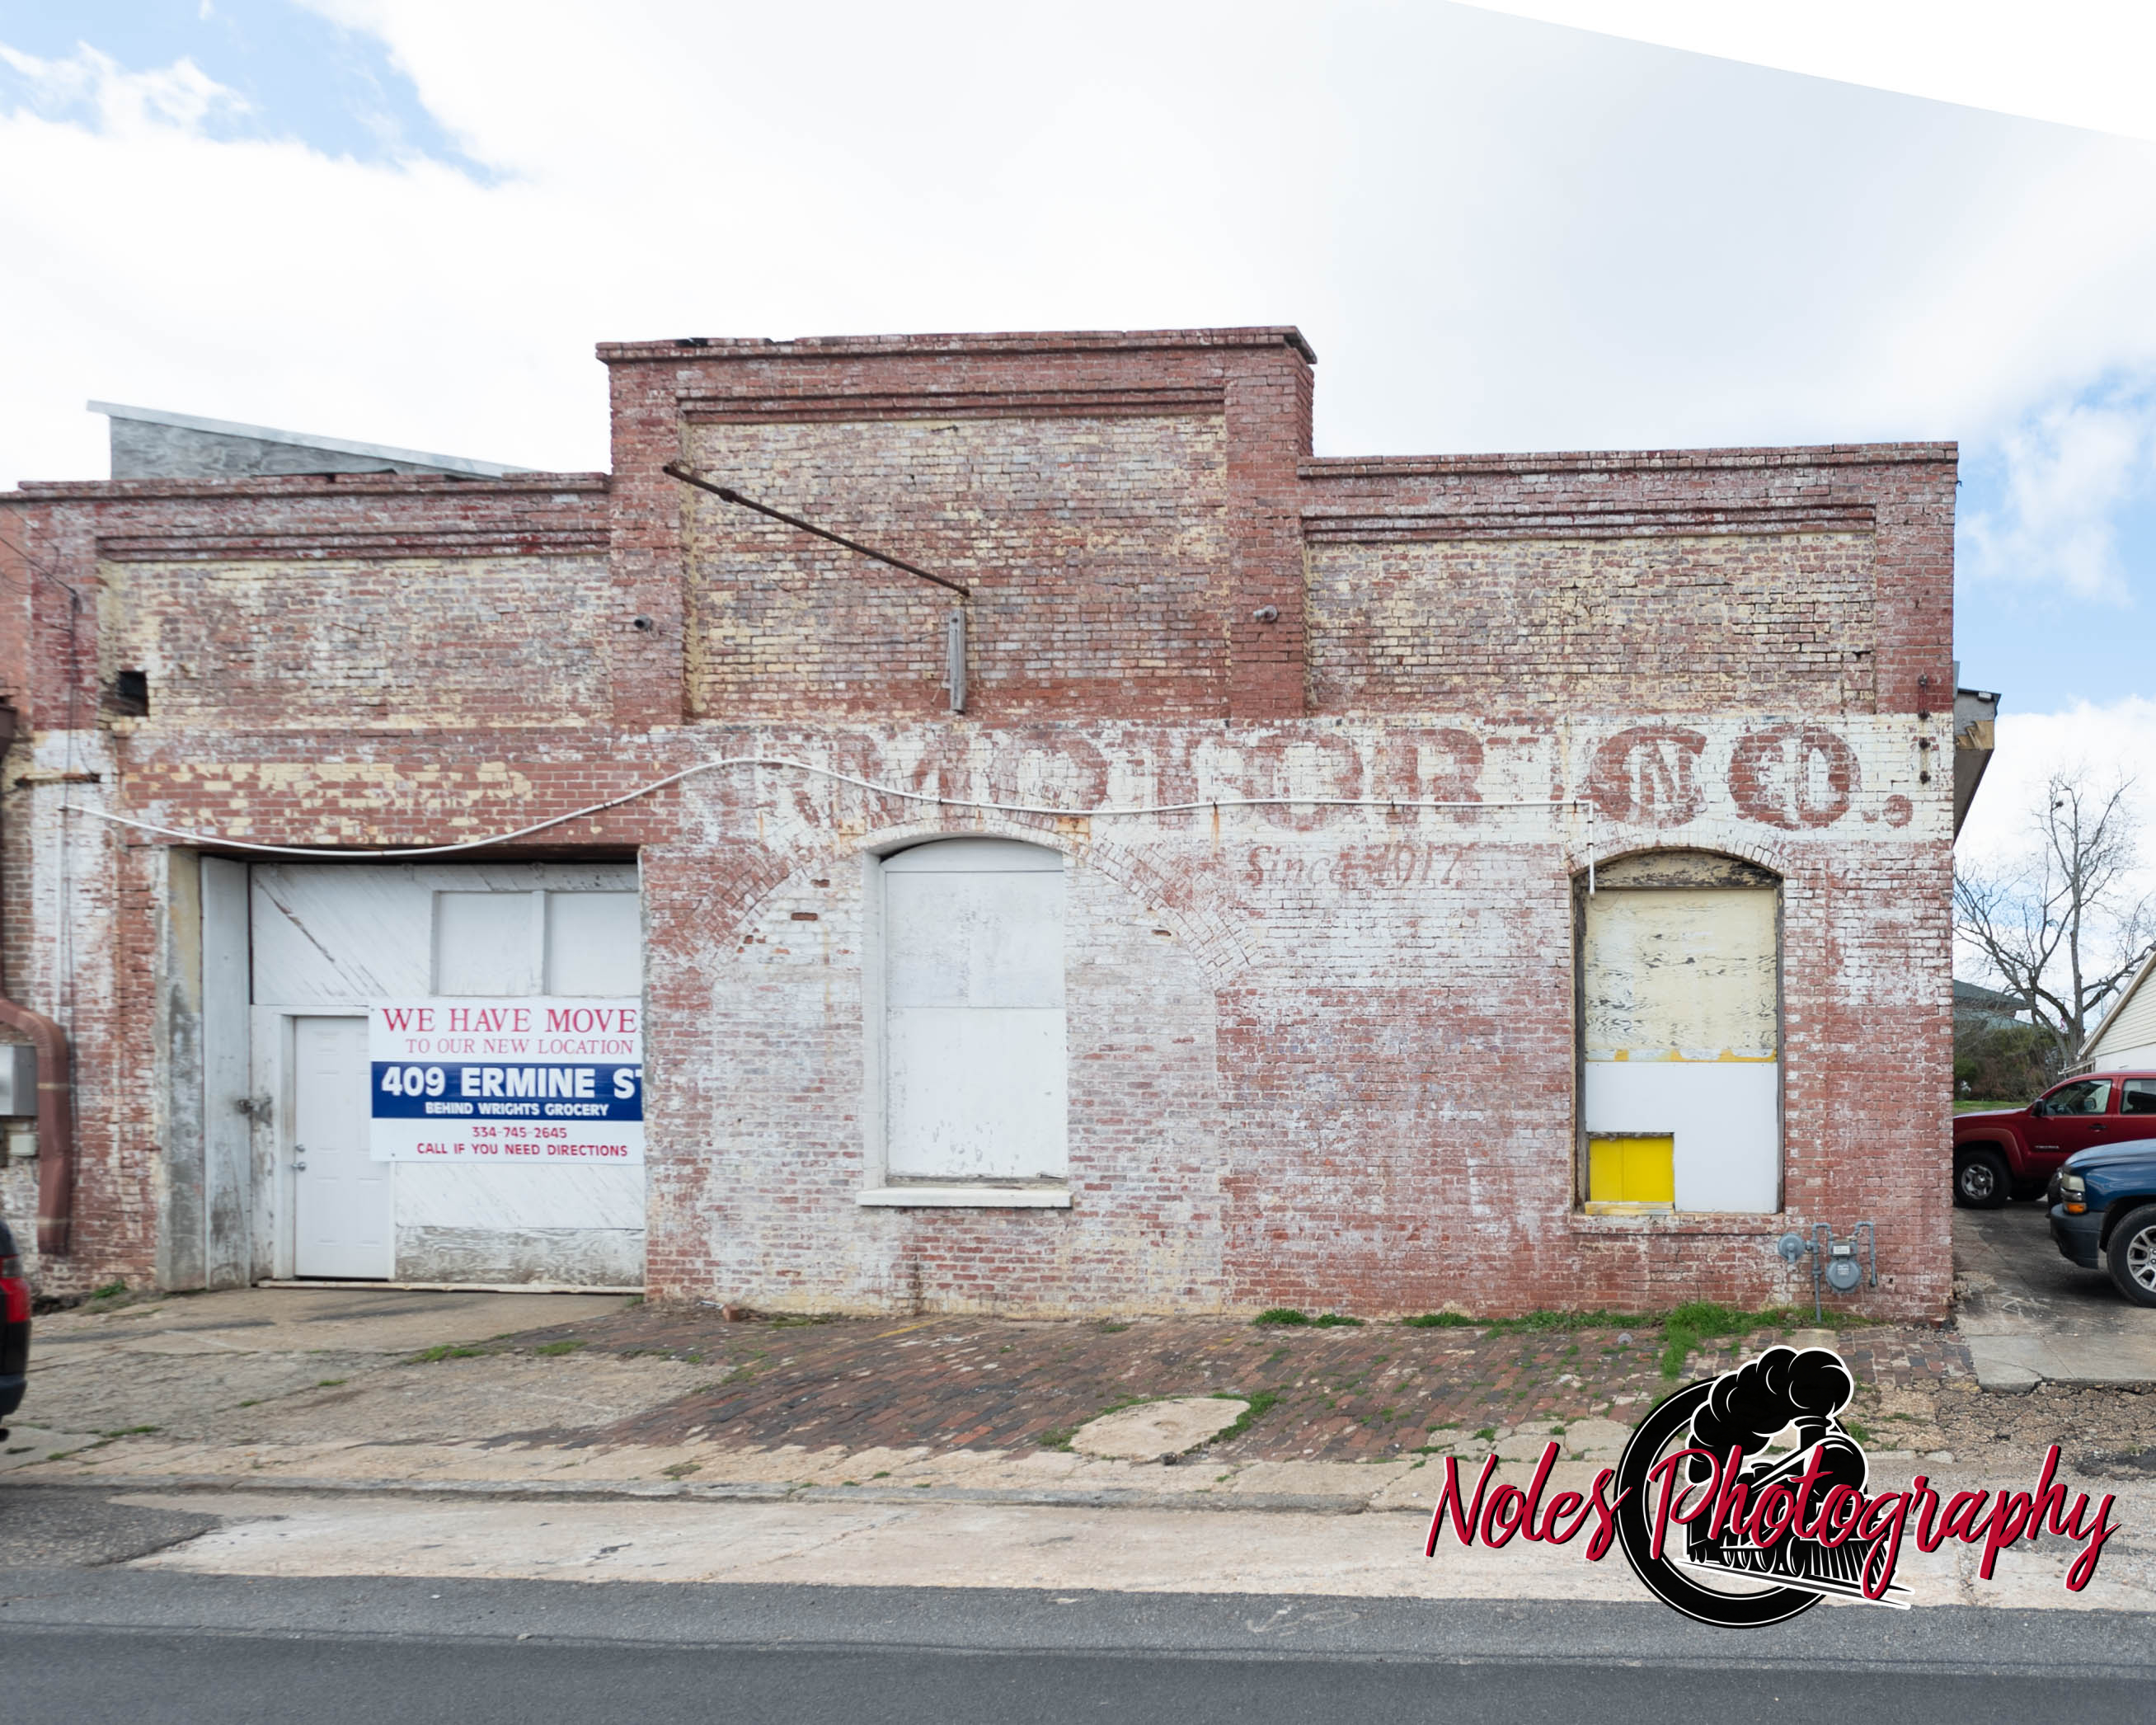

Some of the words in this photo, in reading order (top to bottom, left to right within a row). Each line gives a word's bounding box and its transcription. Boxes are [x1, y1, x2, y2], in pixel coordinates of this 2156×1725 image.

[382, 1008, 436, 1032] WE
[448, 1008, 532, 1033] HAVE
[545, 1008, 641, 1034] MOVE
[406, 1038, 430, 1054] TO
[437, 1038, 476, 1054] OUR
[483, 1038, 530, 1054] NEW
[538, 1039, 634, 1055] LOCATION
[382, 1066, 445, 1097] 409
[461, 1067, 595, 1098] ERMINE
[425, 1101, 473, 1115] BEHIND
[477, 1102, 540, 1116] WRIGHTS
[544, 1102, 609, 1116] GROCERY
[472, 1126, 568, 1139] 334-745-2645
[416, 1142, 448, 1154] CALL
[453, 1142, 466, 1154] IF
[471, 1143, 499, 1155] YOU
[504, 1143, 541, 1155] NEED
[547, 1144, 628, 1157] DIRECTIONS
